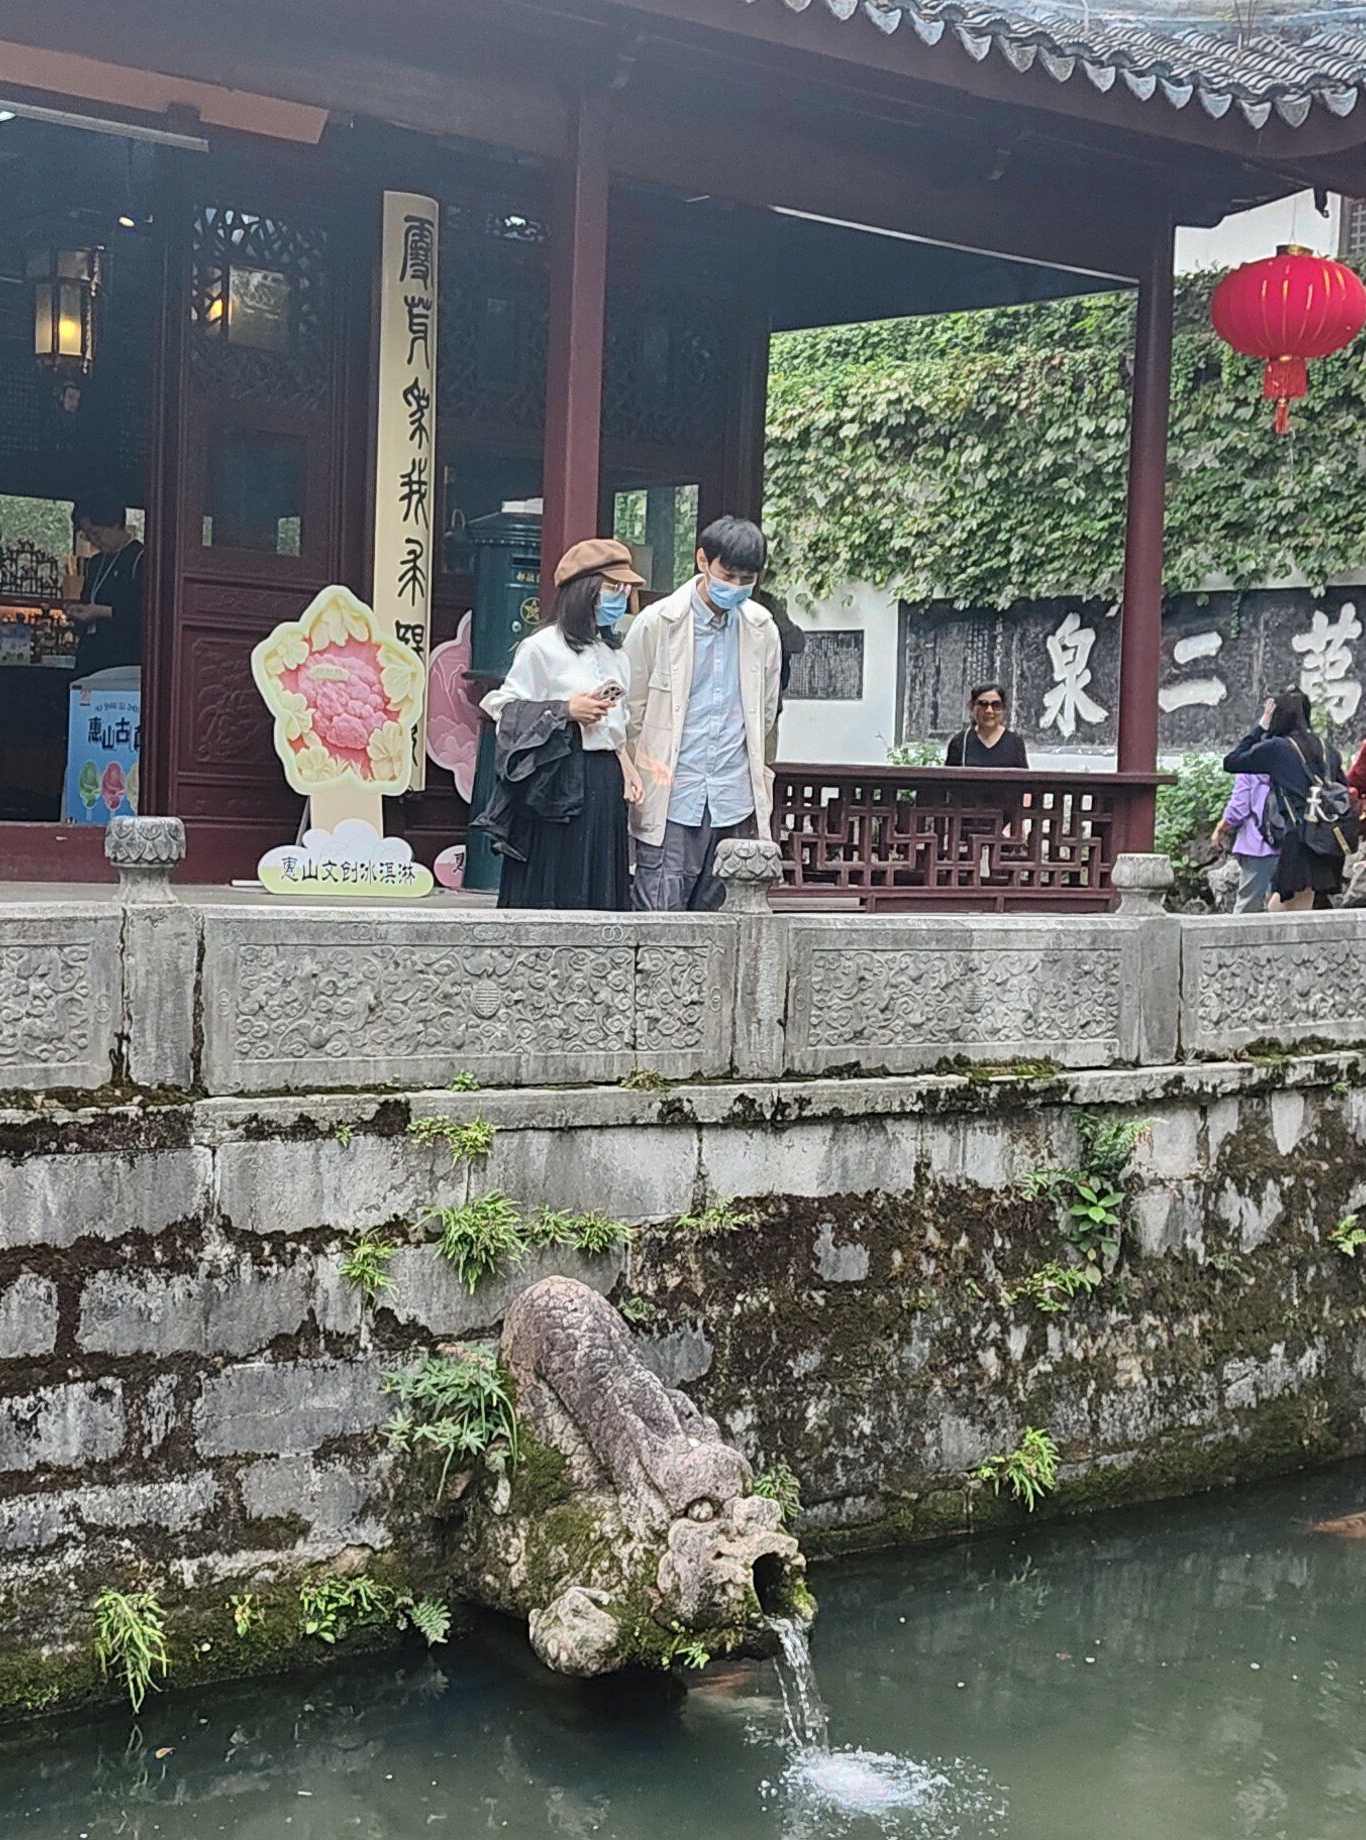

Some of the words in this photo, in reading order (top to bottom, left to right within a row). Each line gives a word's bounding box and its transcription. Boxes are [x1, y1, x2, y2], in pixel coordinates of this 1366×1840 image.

[281, 856, 416, 885] 惠山文创冰淇淋
